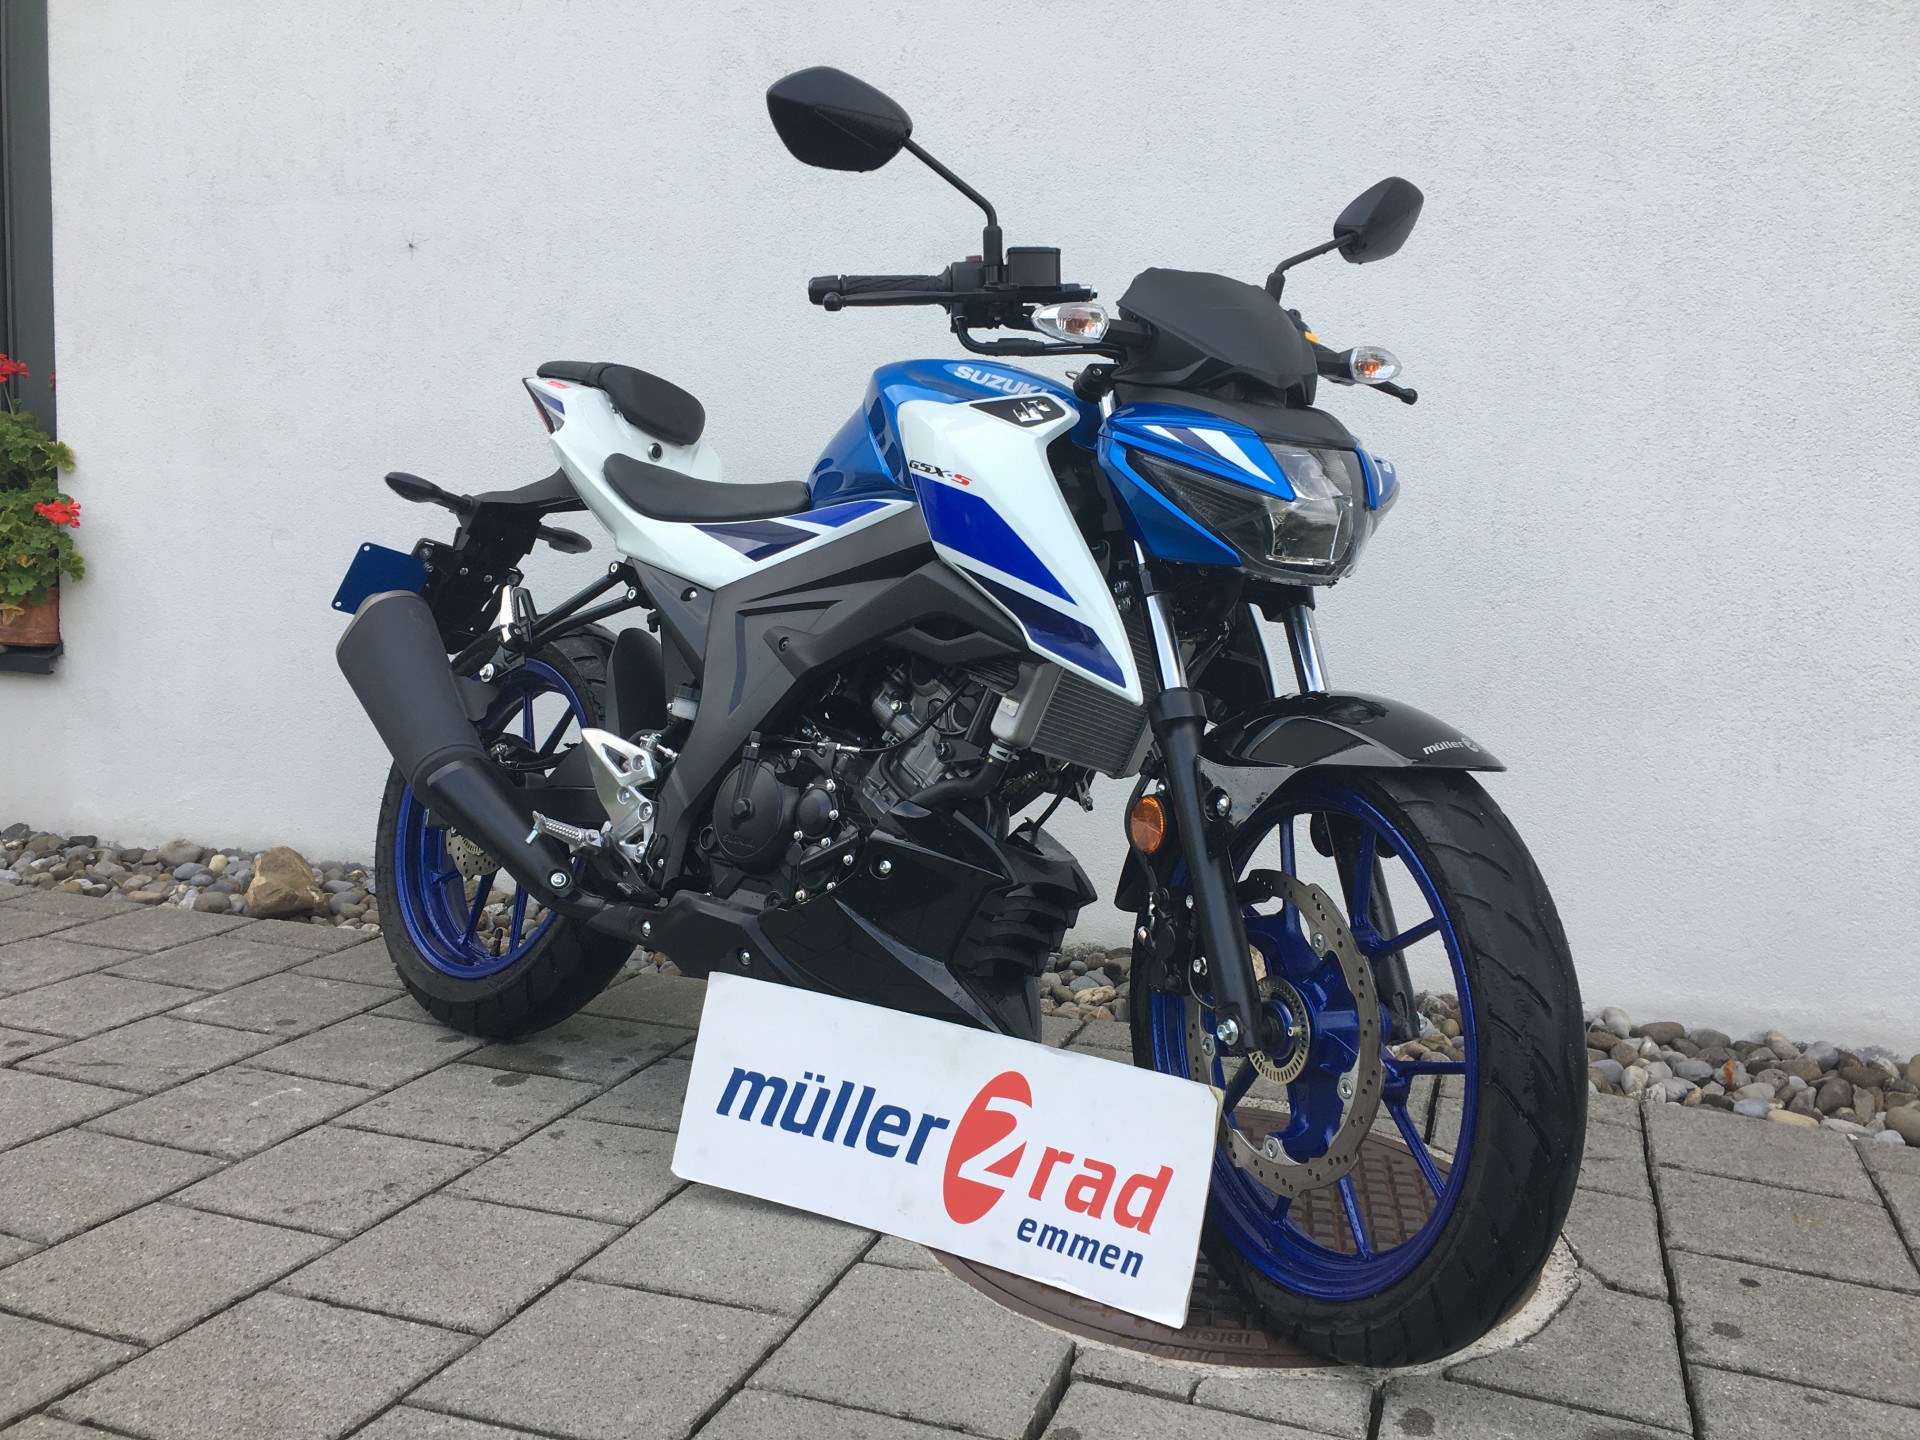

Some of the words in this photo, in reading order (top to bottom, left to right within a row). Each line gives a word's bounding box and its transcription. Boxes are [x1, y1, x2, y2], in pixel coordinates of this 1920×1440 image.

[909, 459, 973, 487] GSX-S
[1422, 740, 1464, 755] müller
[1016, 1217, 1144, 1278] emmen
